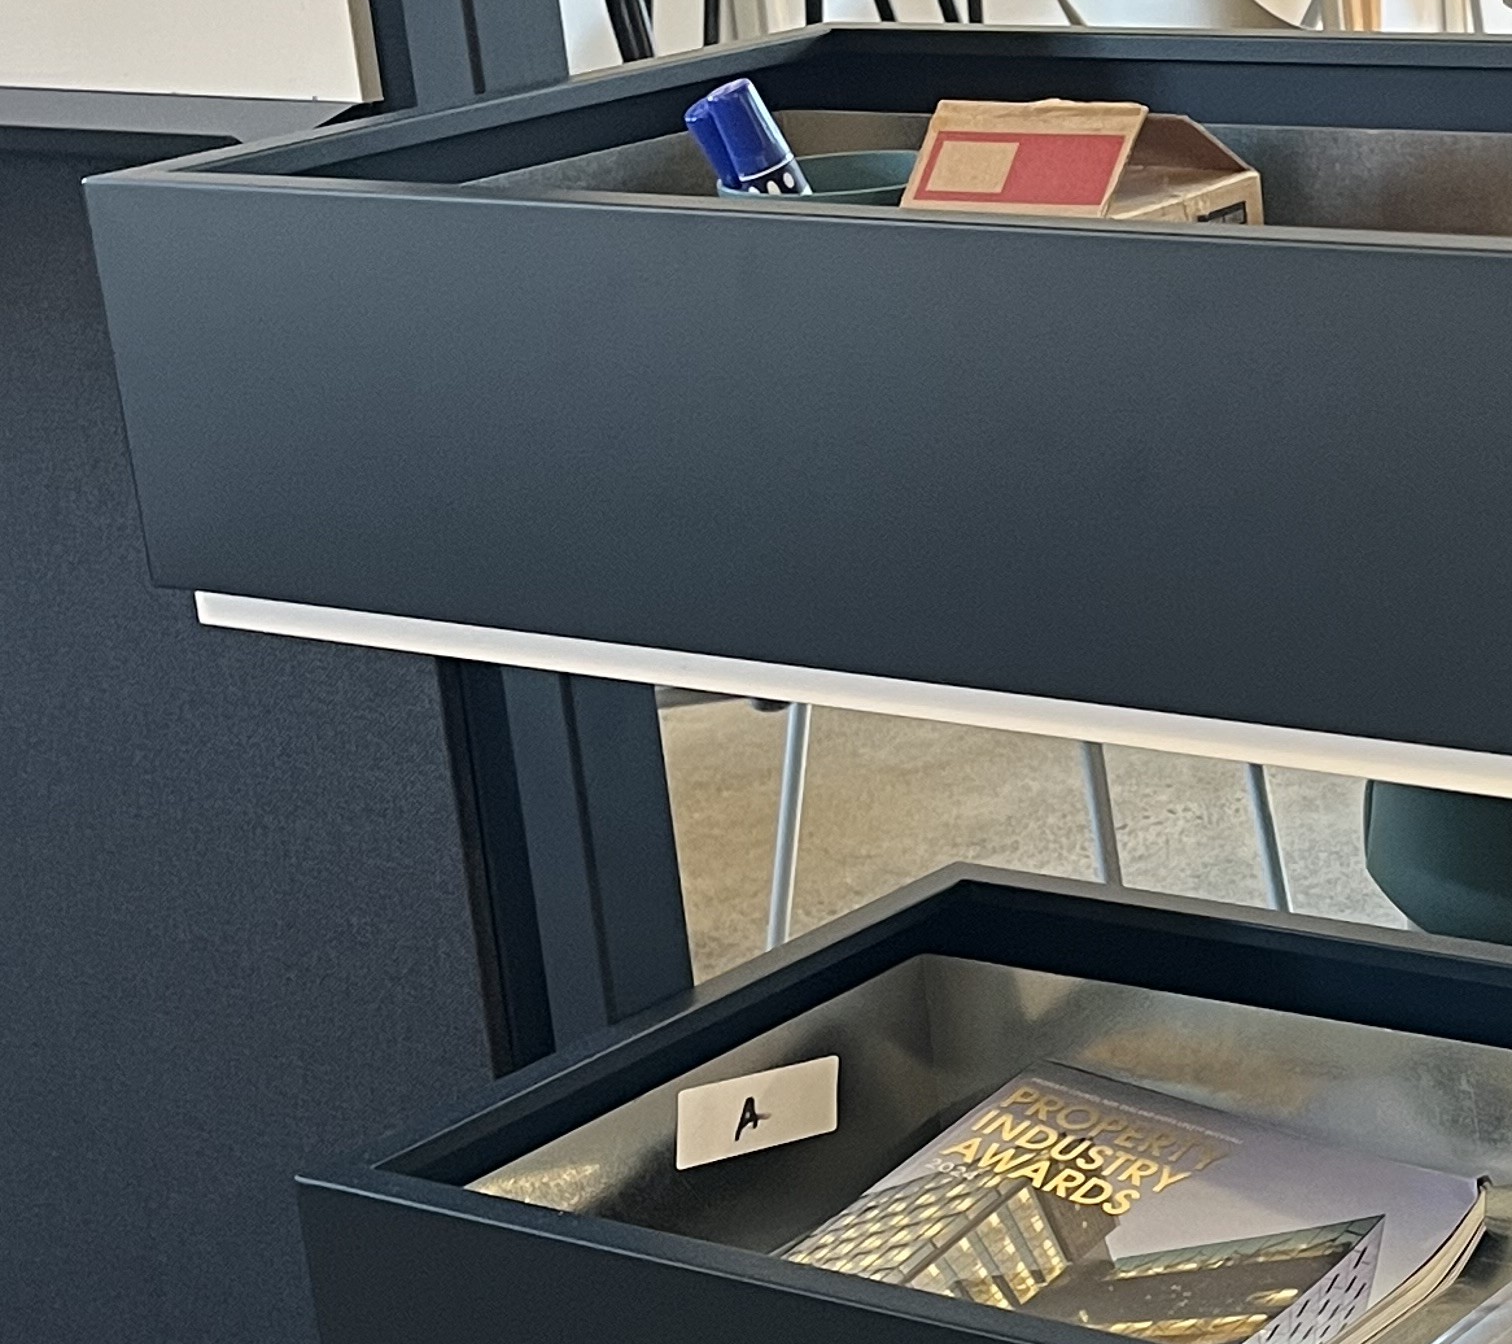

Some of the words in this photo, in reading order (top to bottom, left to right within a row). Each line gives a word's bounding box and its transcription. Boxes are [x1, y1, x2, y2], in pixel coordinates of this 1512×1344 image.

[735, 1096, 771, 1141] A
[971, 1109, 1192, 1193] INDUSTRY
[1000, 1085, 1233, 1170] PROPERTY
[940, 1137, 1141, 1216] AWARDS
